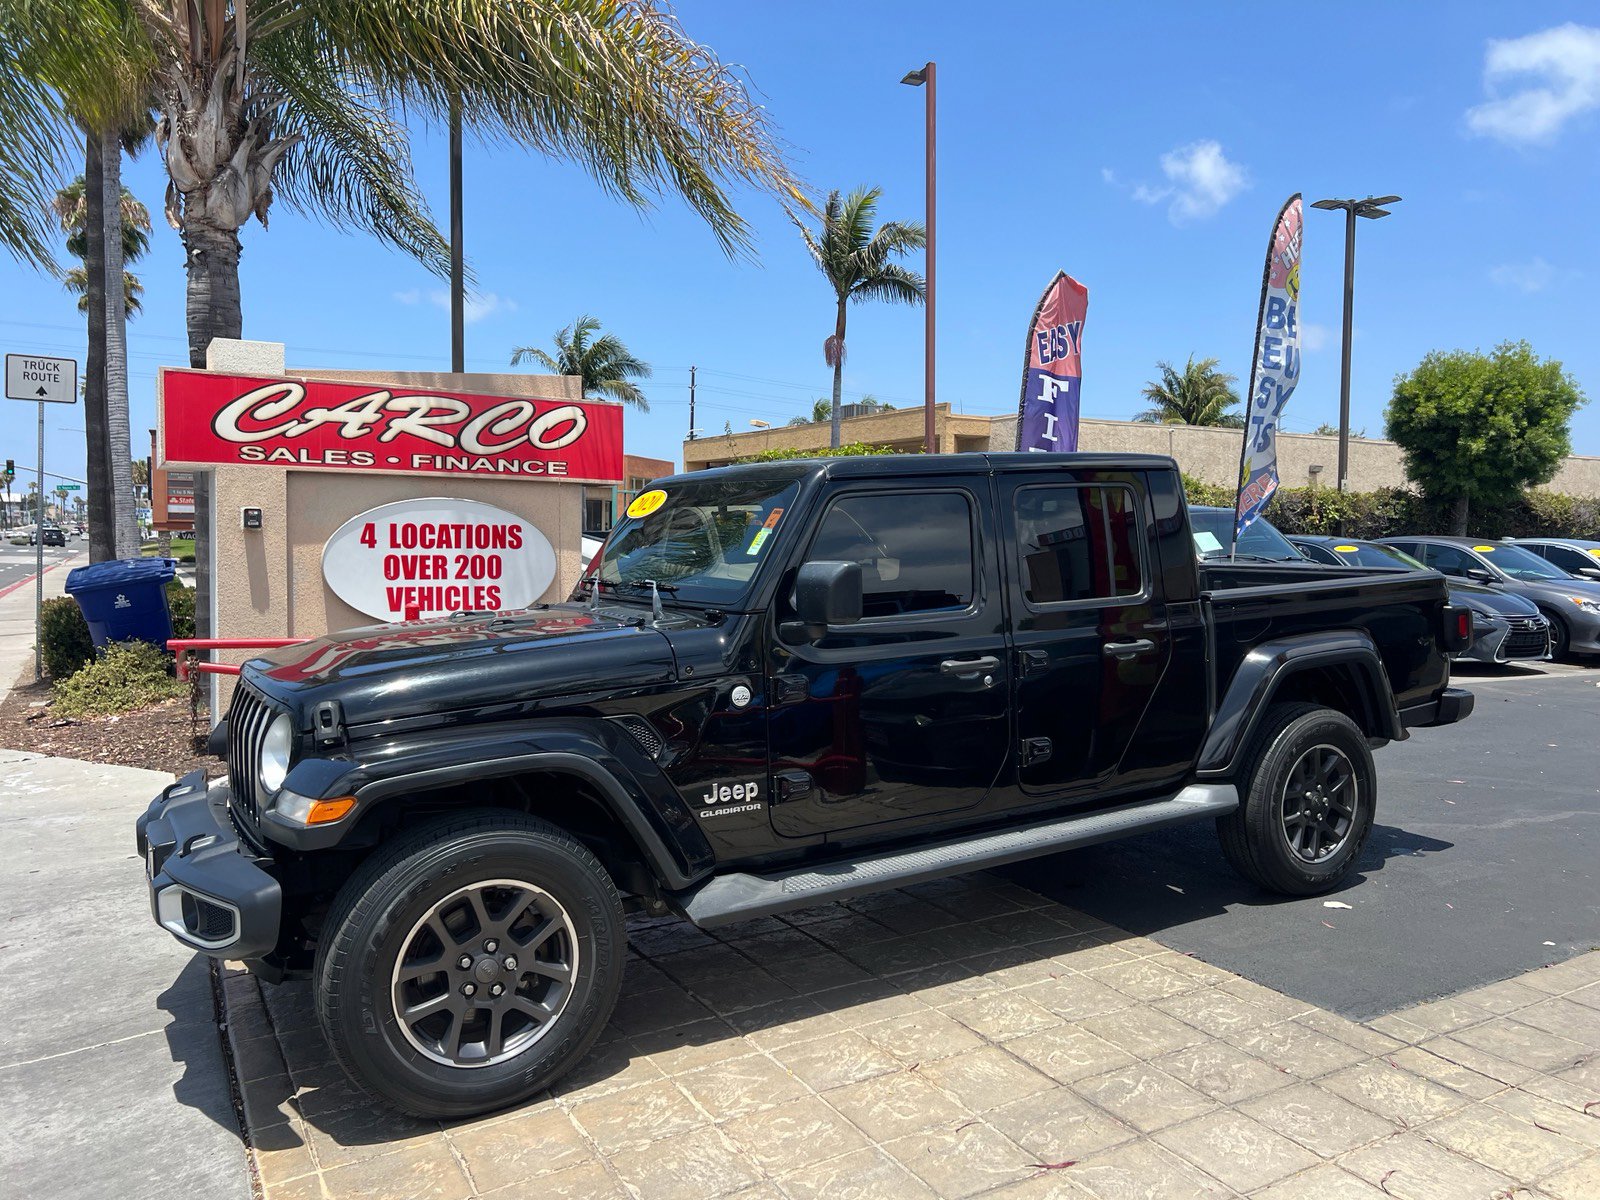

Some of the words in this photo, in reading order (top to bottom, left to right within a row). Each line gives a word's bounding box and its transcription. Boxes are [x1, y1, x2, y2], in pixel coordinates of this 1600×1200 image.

[1037, 321, 1083, 366] EASY
[23, 360, 60, 372] TRUCK
[23, 371, 60, 383] ROUTE
[212, 381, 587, 455] CARCO
[1029, 374, 1070, 452] FI
[239, 446, 376, 466] SALES
[411, 454, 569, 476] FINANCE
[360, 523, 377, 548] 4
[389, 523, 523, 550] LOCATIONS
[384, 555, 448, 581] OVER
[454, 555, 502, 580] 200
[386, 585, 502, 612] VEHICLES
[703, 782, 759, 804] Jeep
[700, 803, 761, 818] GLADIATOR
